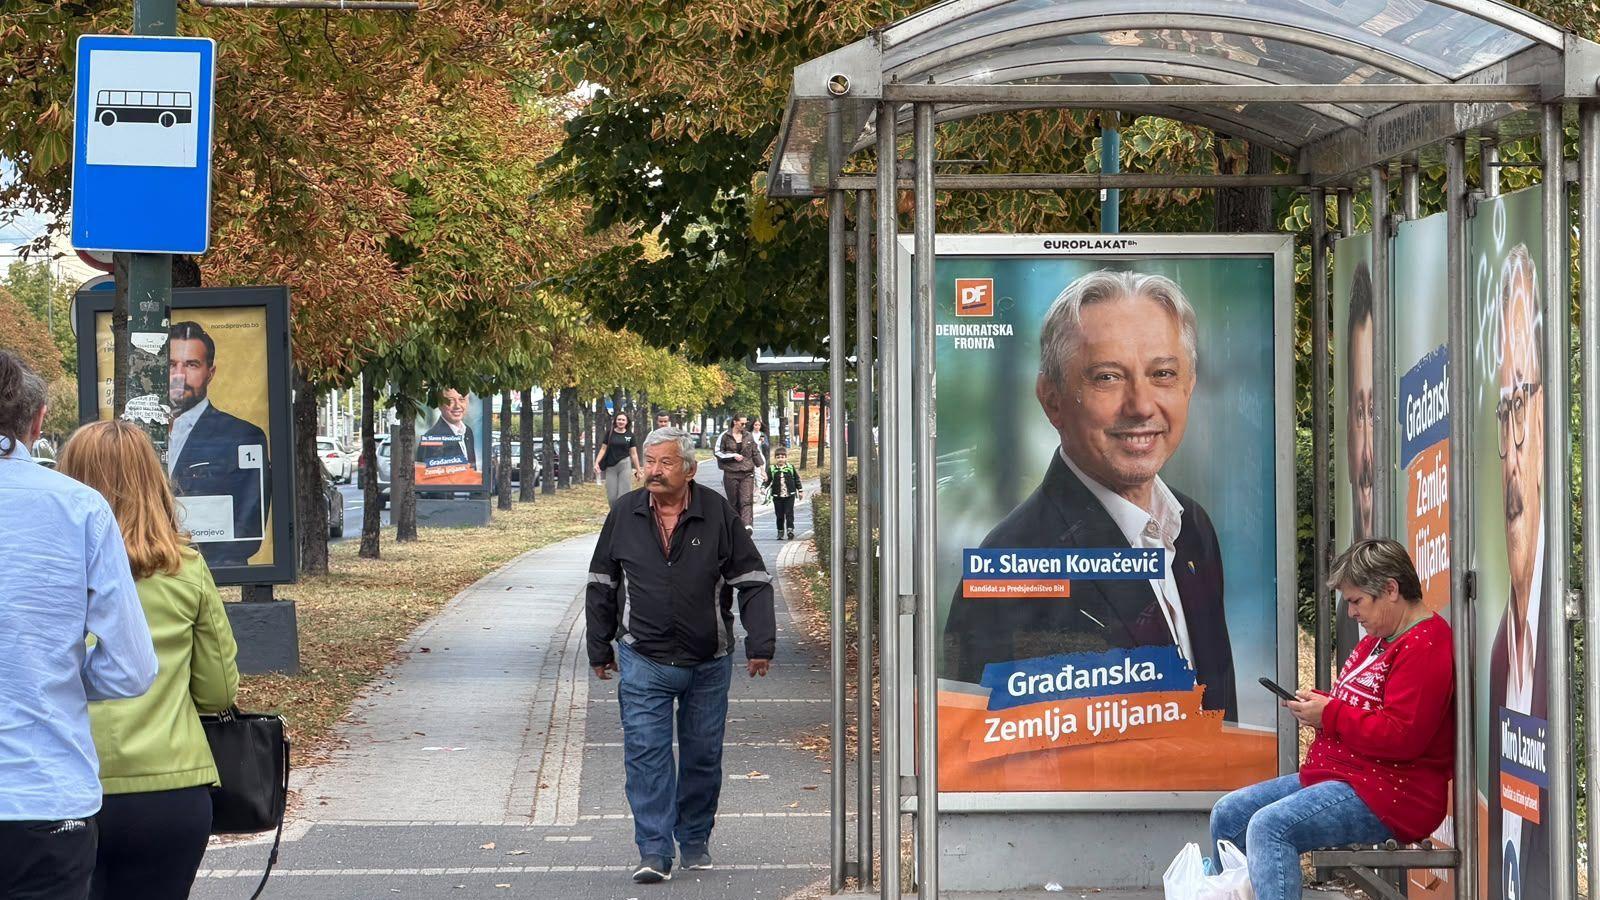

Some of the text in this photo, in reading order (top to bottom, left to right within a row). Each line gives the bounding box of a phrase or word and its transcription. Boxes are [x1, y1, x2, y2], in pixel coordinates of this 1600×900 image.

[961, 284, 988, 305] DF
[935, 324, 1014, 336] DEMOKRATSKA
[954, 337, 995, 349] FRONTA
[245, 451, 256, 462] 1.
[1415, 450, 1448, 518] Zemlja
[970, 551, 1159, 574] Dr. Slaven Kovačević
[969, 584, 998, 593] Kandidat
[1006, 584, 1053, 594] Predsjedništvo
[1053, 584, 1065, 592] BiH
[1007, 657, 1164, 697] Građanska.
[983, 699, 1188, 743] Zemlja ljiljana.
[1501, 717, 1546, 774] Miro Lazović
